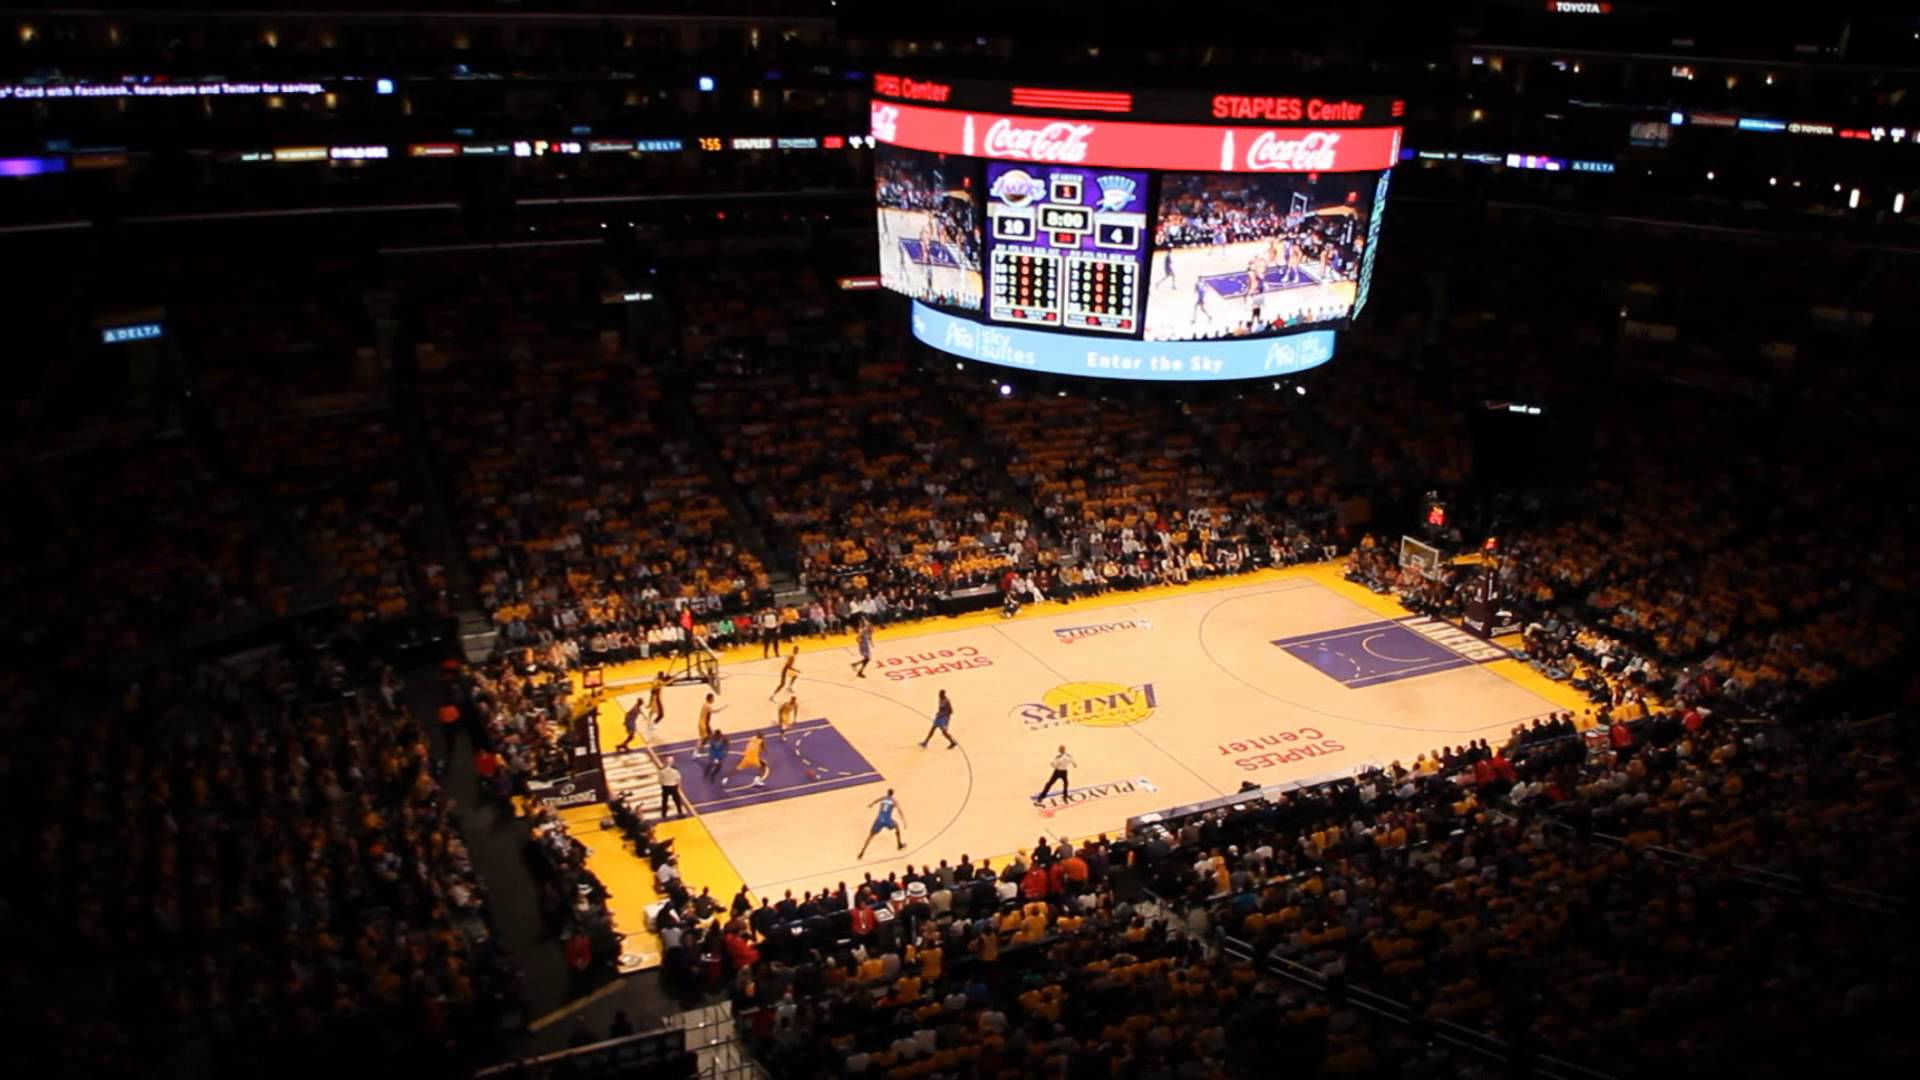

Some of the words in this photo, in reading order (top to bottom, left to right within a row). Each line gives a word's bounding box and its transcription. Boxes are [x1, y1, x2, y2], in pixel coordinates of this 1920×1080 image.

[1556, 2, 1600, 14] TOYOTA
[14, 87, 44, 98] Card
[46, 86, 72, 97] with
[199, 84, 220, 95] and
[222, 83, 260, 94] Twitter
[263, 83, 279, 94] for
[902, 78, 949, 101] Center
[1213, 95, 1302, 120] STAPLES
[1307, 99, 1364, 120] Center
[1801, 124, 1834, 135] TOYOTA
[647, 140, 683, 151] DELTA
[1581, 161, 1615, 172] DELTA
[1004, 219, 1025, 235] 10
[1110, 228, 1124, 244] 4
[117, 325, 160, 340] DELTA
[1087, 351, 1142, 370] Enter
[1151, 355, 1182, 372] the
[1190, 355, 1223, 373] Sky
[875, 646, 979, 668] Center
[885, 656, 993, 681] STAPLES
[1010, 683, 1158, 722] LAKERS
[1218, 728, 1324, 755] Center
[1235, 740, 1345, 771] STAPLES
